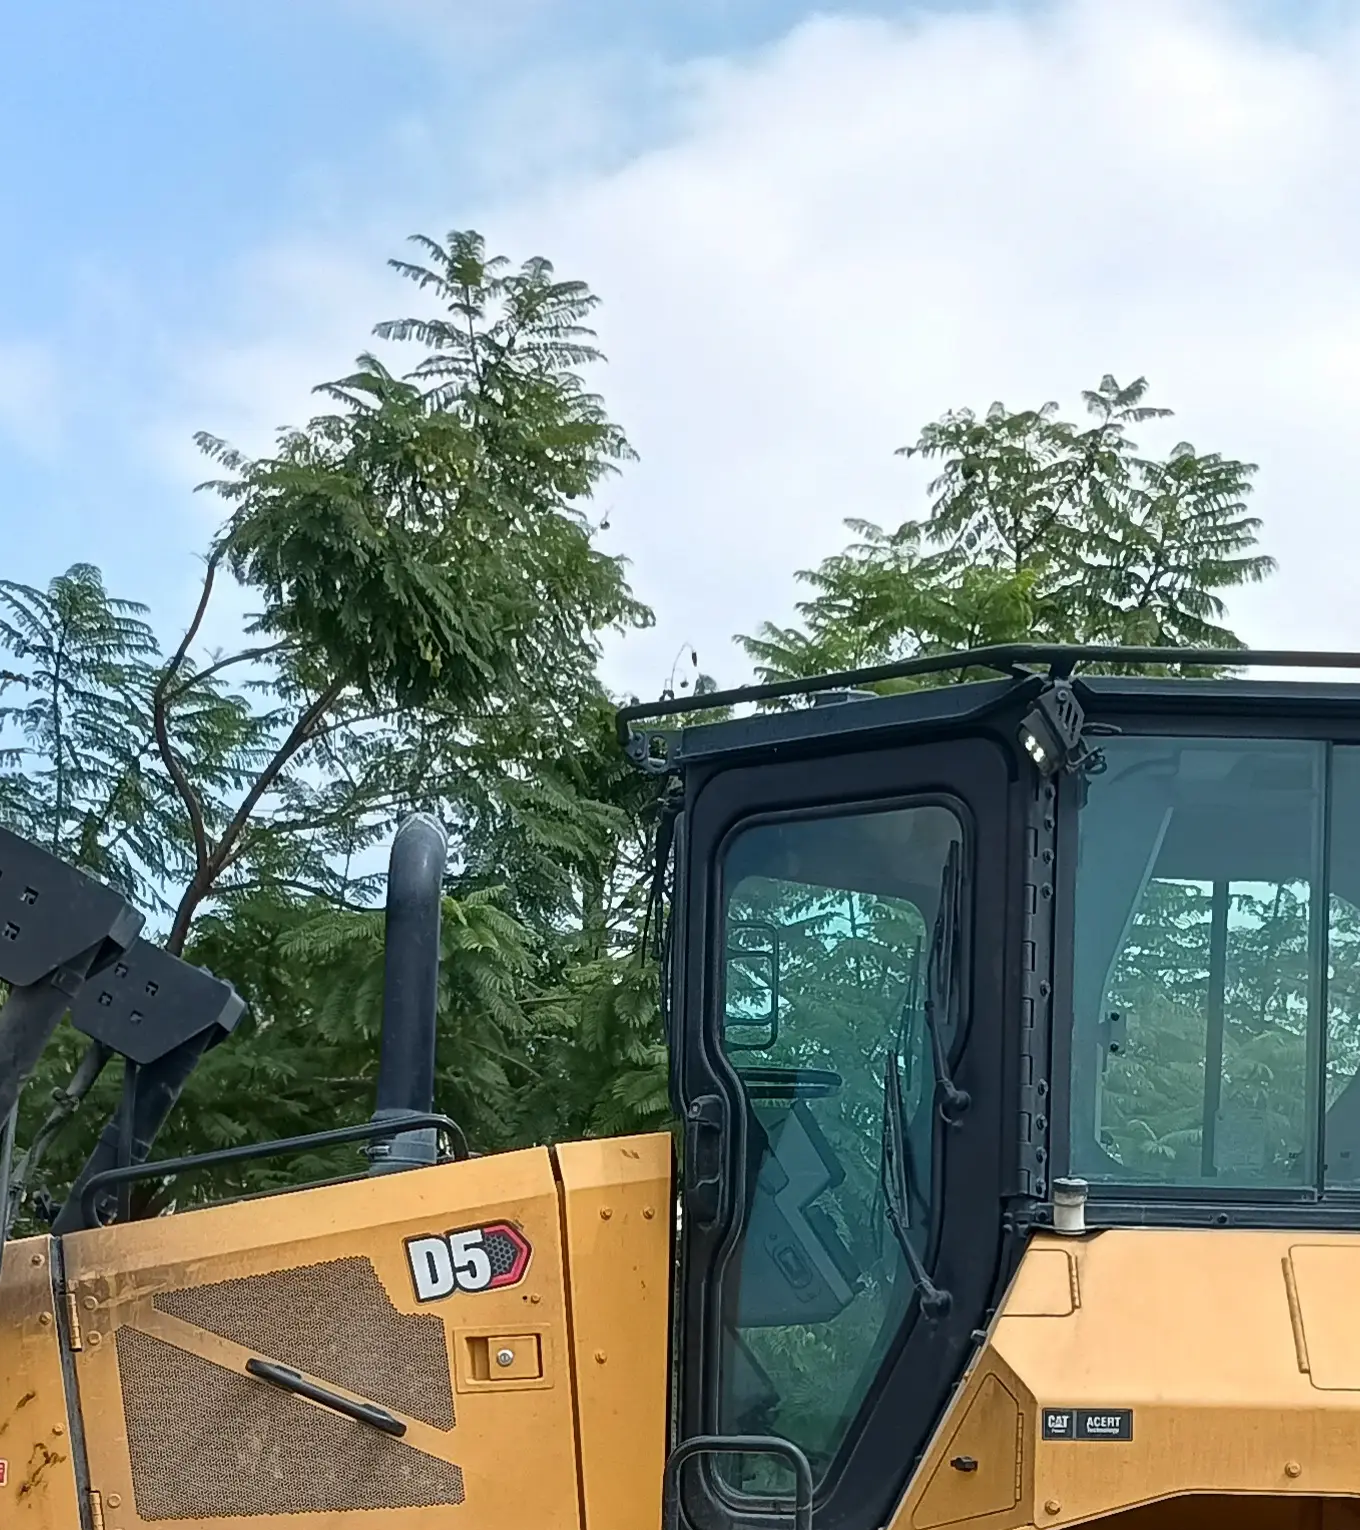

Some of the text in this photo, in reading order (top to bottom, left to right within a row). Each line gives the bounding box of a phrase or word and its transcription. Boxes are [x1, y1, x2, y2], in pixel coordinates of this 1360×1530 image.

[408, 1229, 491, 1299] D5
[1048, 1415, 1069, 1428] CAT
[1087, 1416, 1121, 1427] ACERT
